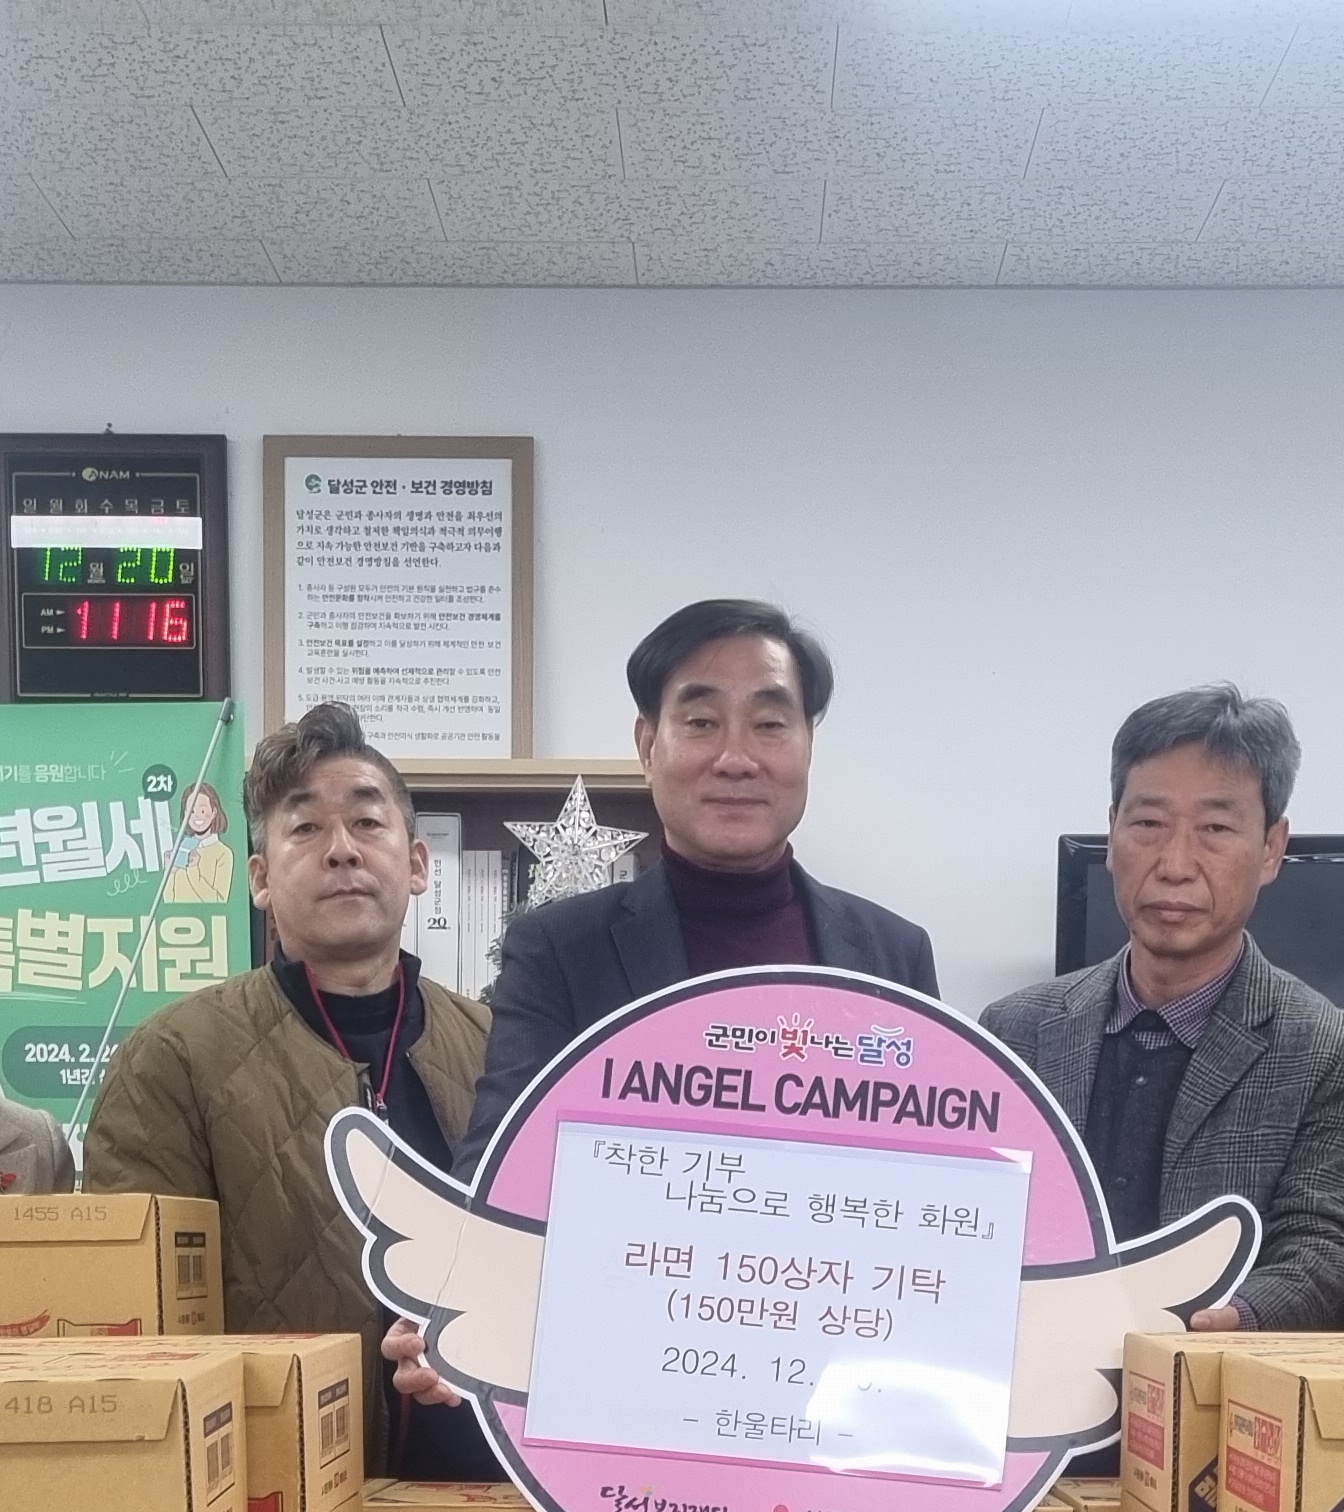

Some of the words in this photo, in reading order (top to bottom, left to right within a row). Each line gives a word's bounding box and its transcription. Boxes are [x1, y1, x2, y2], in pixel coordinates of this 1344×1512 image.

[328, 479, 367, 495] 달성군
[370, 479, 397, 495] 안전
[410, 480, 437, 495] 보건
[440, 480, 493, 496] 경영방침
[23, 498, 37, 514] 일
[50, 498, 63, 514] 월
[75, 498, 88, 514] 화
[100, 498, 114, 514] 수
[125, 498, 138, 514] 목
[151, 498, 164, 514] 금
[176, 498, 190, 514] 토
[88, 562, 104, 578] 월
[179, 562, 194, 578] 일
[33, 763, 106, 783] 응원합니다
[146, 775, 174, 793] 2차
[24, 1043, 75, 1063] 2024.
[857, 1036, 914, 1068] 달성
[601, 1057, 614, 1100] I
[618, 1060, 766, 1113] ANGEL
[774, 1073, 1001, 1133] CAMPAIGN
[682, 1150, 746, 1184] 기부
[14, 1207, 59, 1221] 1455
[70, 1207, 107, 1221] A15
[665, 1181, 791, 1218] 나눔으로
[807, 1192, 905, 1231] 행복한
[624, 1241, 695, 1279] 라면
[717, 1251, 855, 1295] 150상자
[871, 1264, 947, 1304] 기탁
[665, 1288, 799, 1331] (150만원
[818, 1305, 895, 1342] 상당)
[661, 1346, 747, 1380] 2024.
[769, 1356, 816, 1387] 12.
[68, 1395, 117, 1413] A15
[714, 1408, 823, 1446] 한울타리
